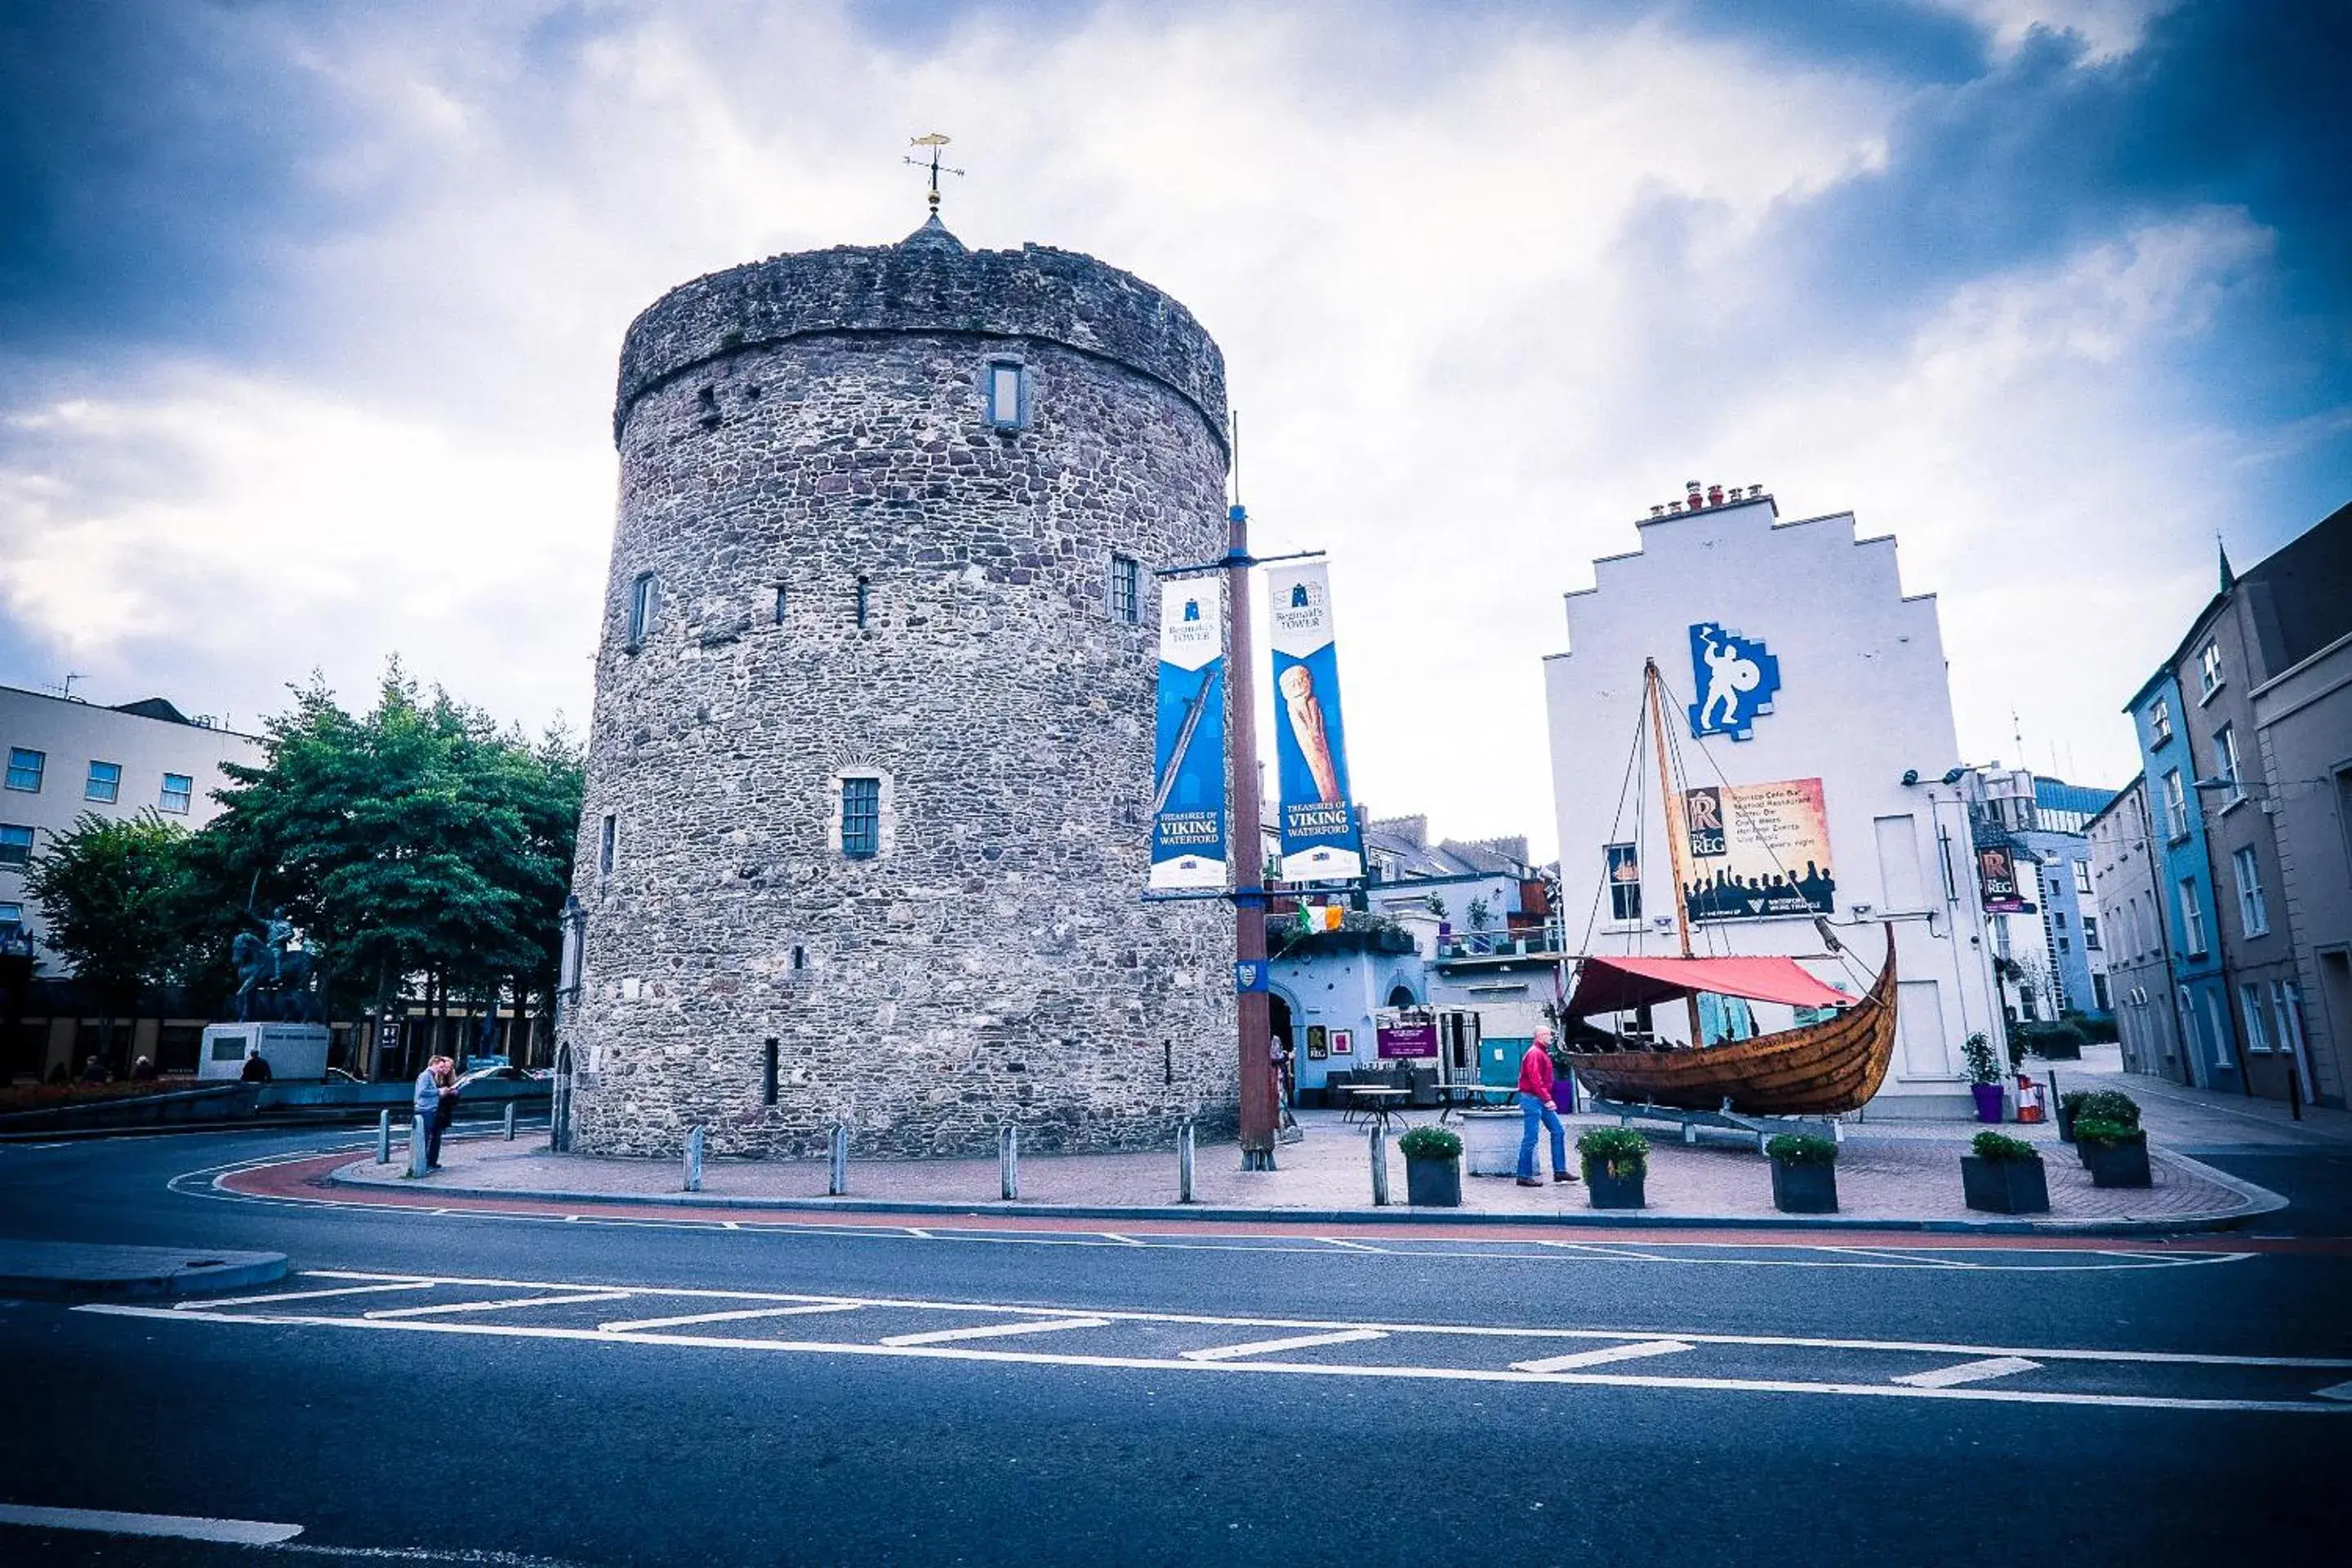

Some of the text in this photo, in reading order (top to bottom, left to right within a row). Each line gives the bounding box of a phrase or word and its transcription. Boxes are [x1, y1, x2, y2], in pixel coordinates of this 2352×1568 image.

[1281, 617, 1320, 630] TOWER
[1286, 800, 1347, 813] TREASURES OF
[1160, 811, 1218, 822] TREASURES OF
[1288, 810, 1348, 827] VIKING
[1160, 820, 1218, 835] VIKING
[1287, 824, 1349, 838] WATERFORD
[1160, 835, 1219, 846] WATERFORD
[1693, 837, 1726, 855] REG
[1987, 882, 2013, 895] REG
